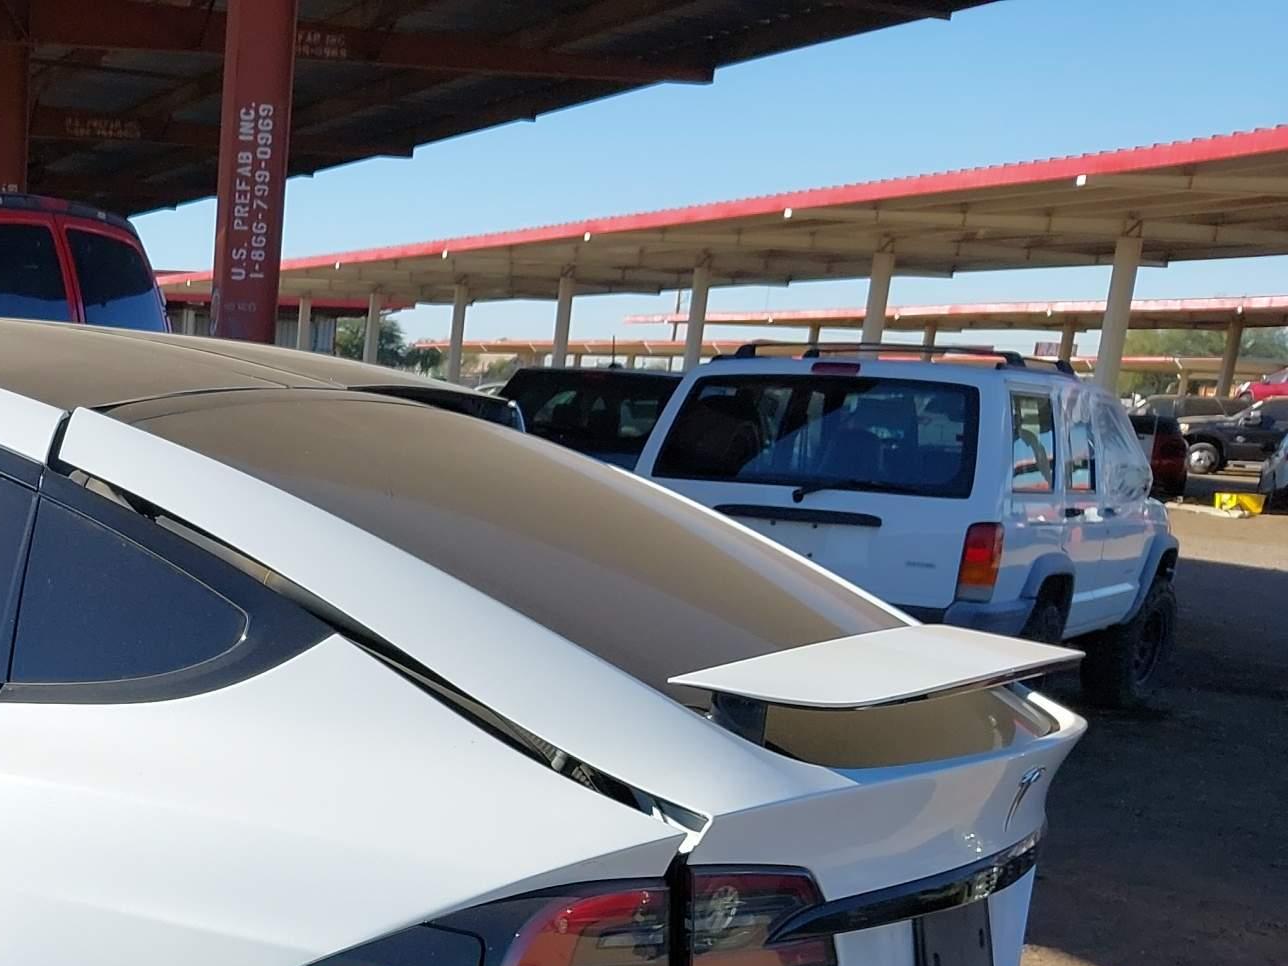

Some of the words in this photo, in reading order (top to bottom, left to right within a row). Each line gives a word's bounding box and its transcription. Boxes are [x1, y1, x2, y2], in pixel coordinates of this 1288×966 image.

[238, 102, 256, 141] INC.
[233, 151, 253, 231] PREFAB
[250, 103, 274, 279] 1-866-799-0969
[231, 243, 248, 280] U.S.
